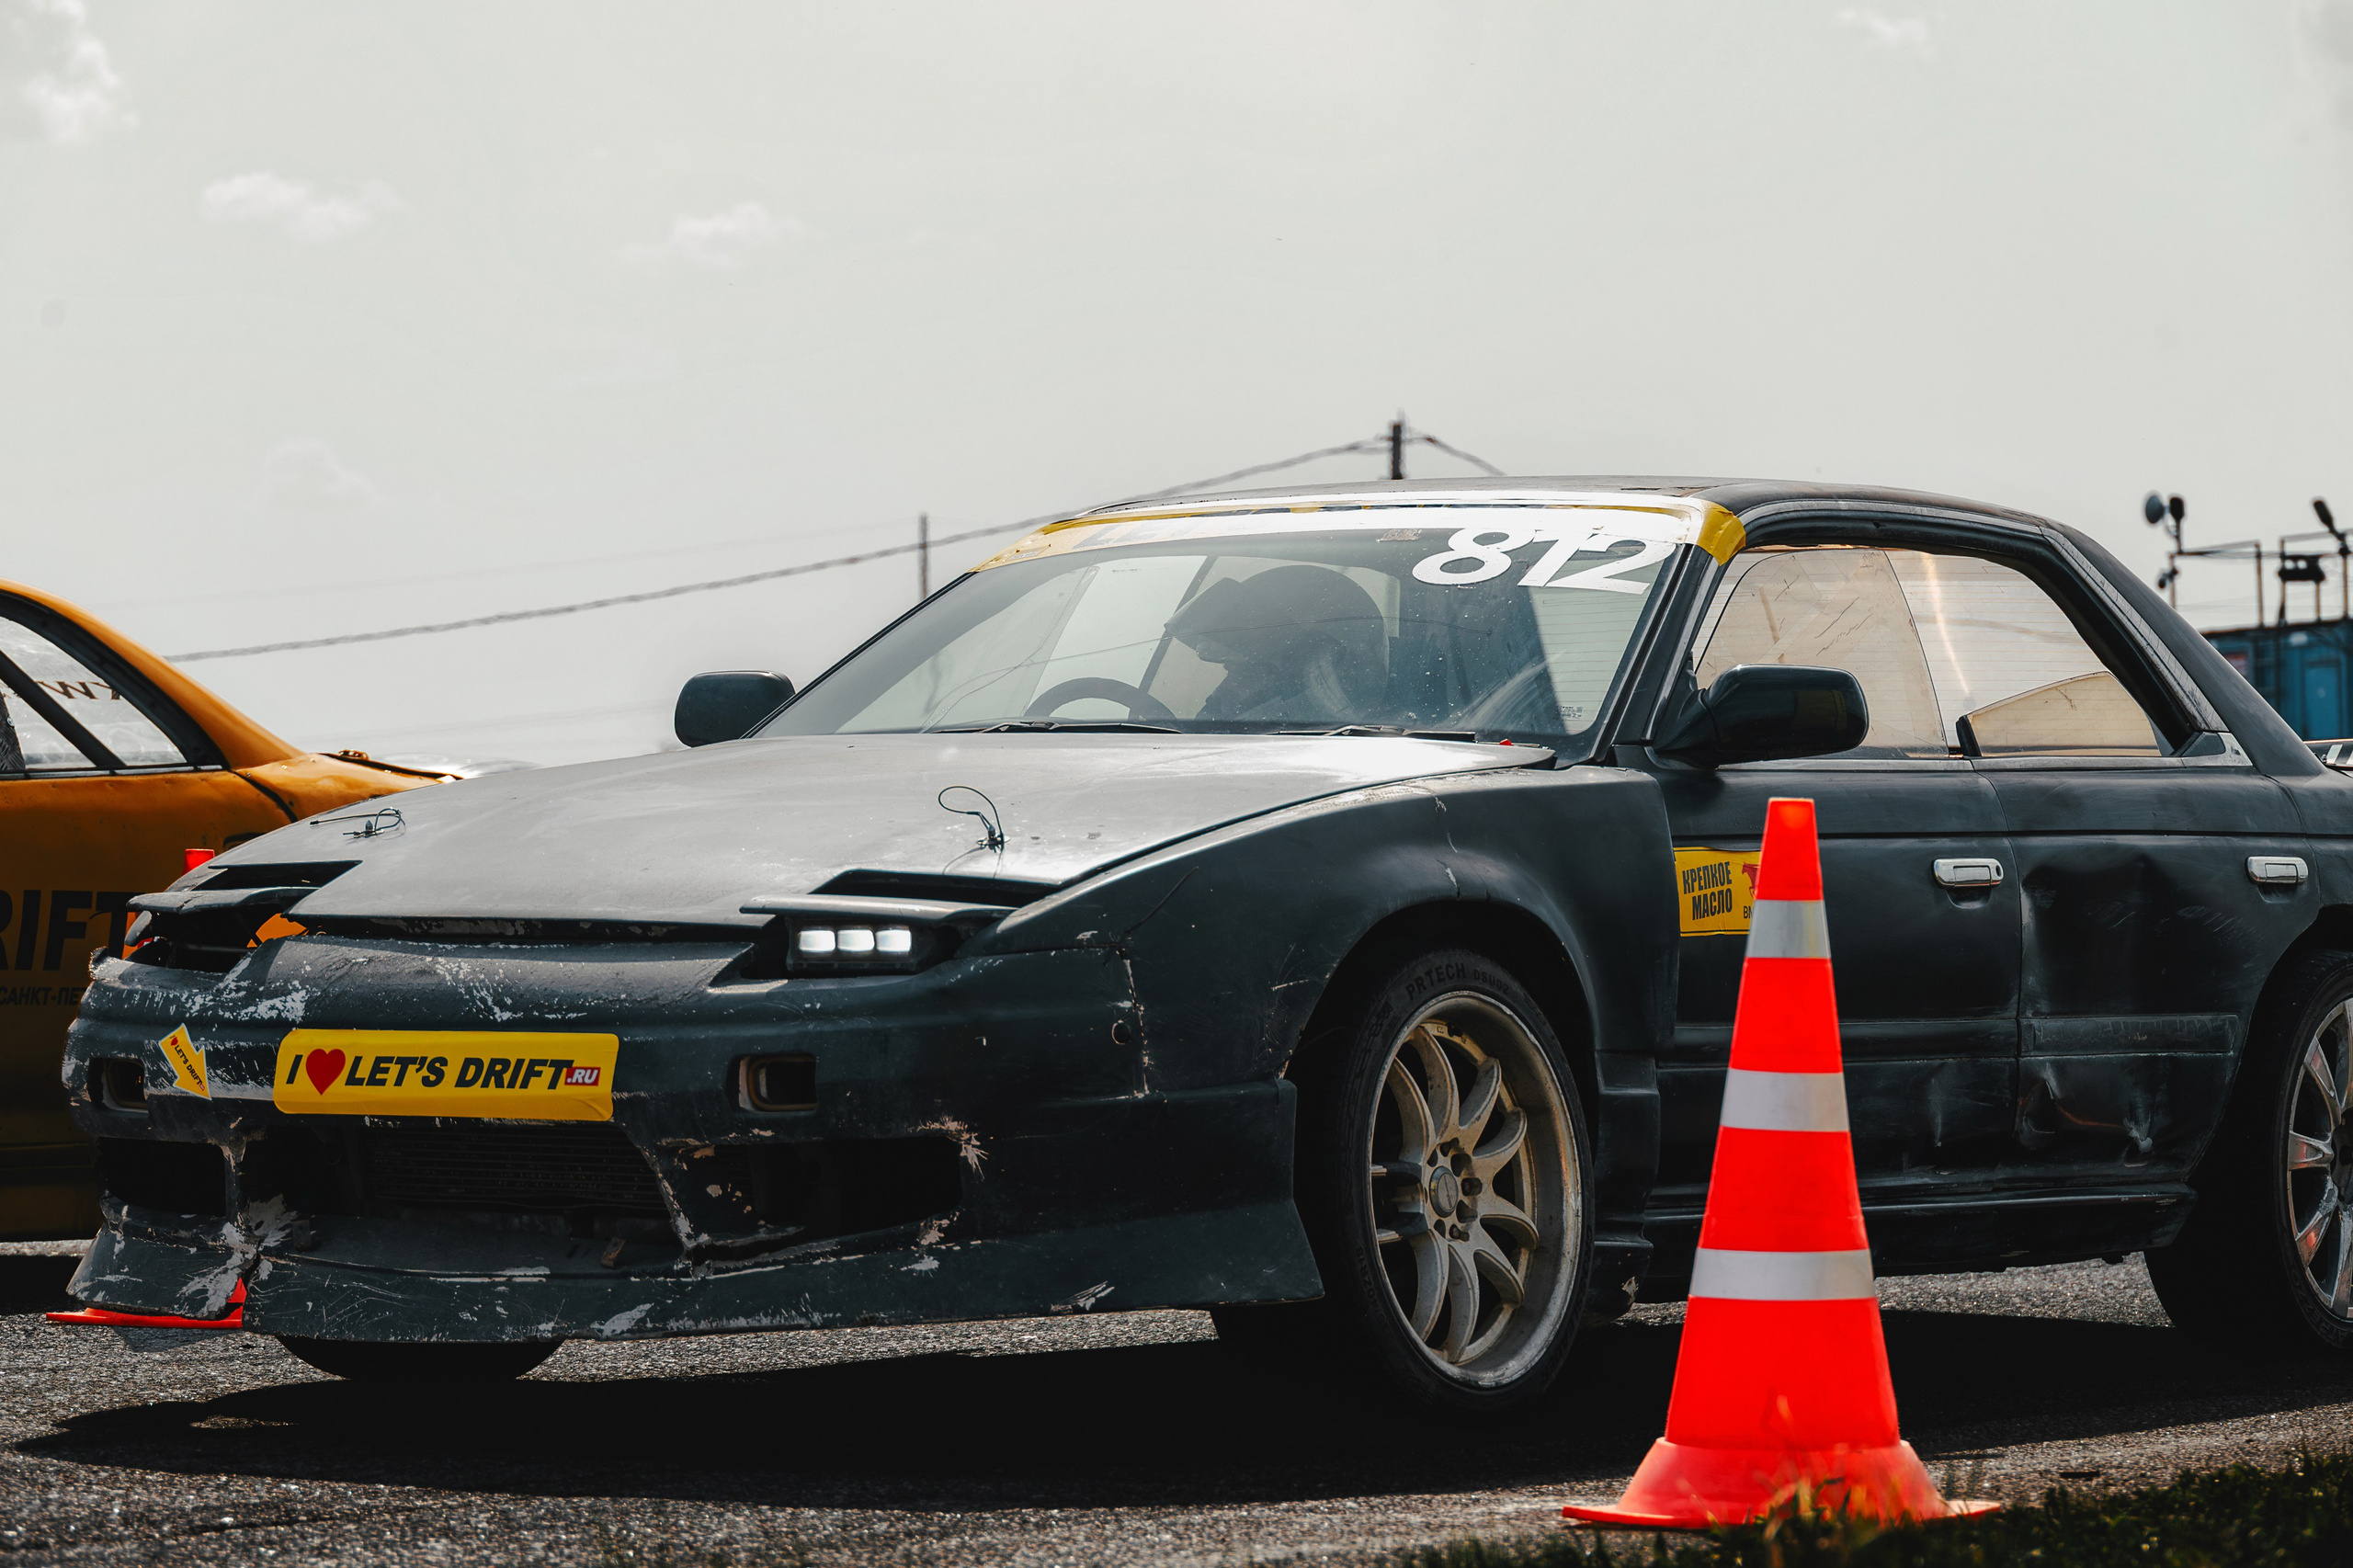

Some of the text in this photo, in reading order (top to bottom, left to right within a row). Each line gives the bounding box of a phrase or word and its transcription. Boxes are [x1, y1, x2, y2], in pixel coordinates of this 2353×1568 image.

[1412, 528, 1676, 595] 812
[1682, 861, 1732, 894] КРЕПКОЕ
[1692, 888, 1733, 920] МАСЛО
[0, 986, 86, 1006] САНКТ-ПЕ
[286, 1054, 303, 1085] I
[345, 1056, 448, 1087] LET'S
